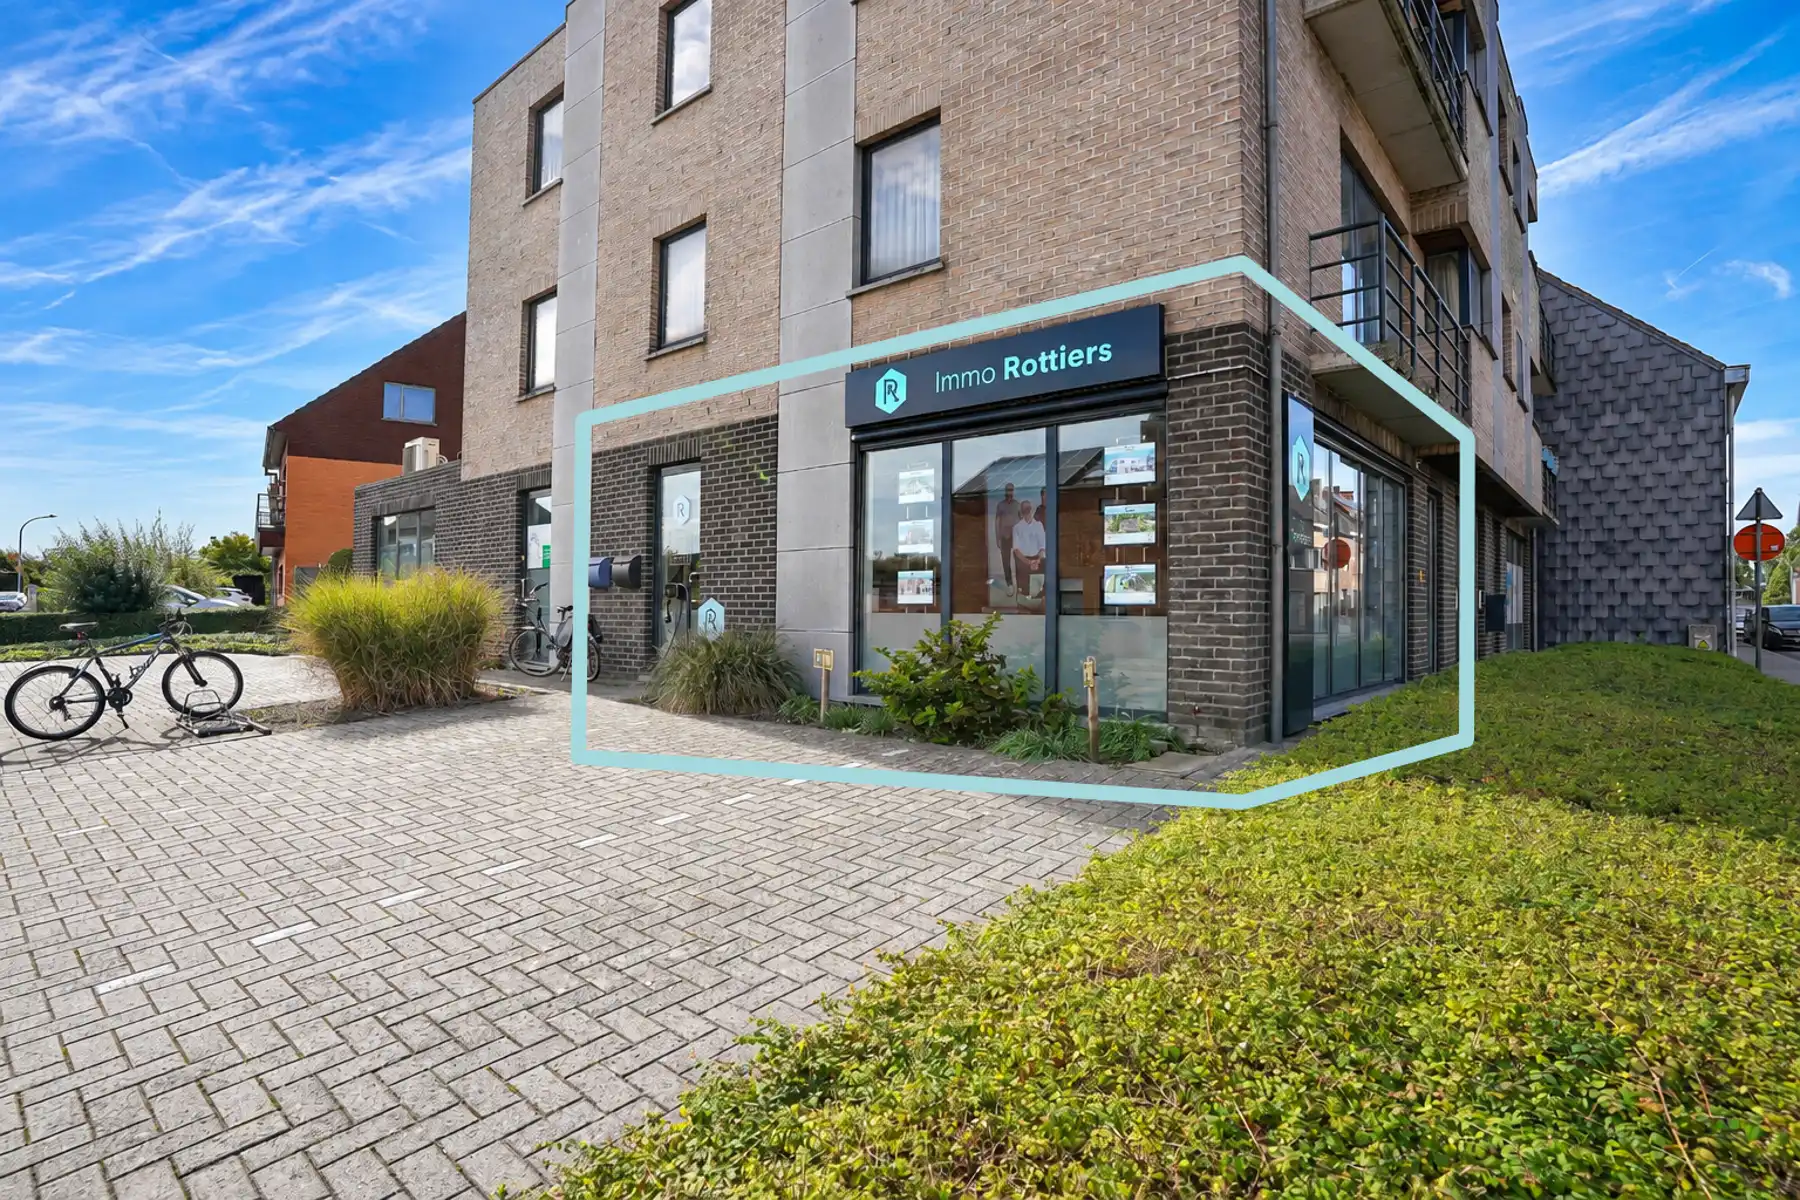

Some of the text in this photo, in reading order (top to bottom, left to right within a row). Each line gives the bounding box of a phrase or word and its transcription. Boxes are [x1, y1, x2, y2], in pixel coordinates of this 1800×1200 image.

[936, 343, 1112, 393] Immo Rottiers
[883, 379, 899, 404] R
